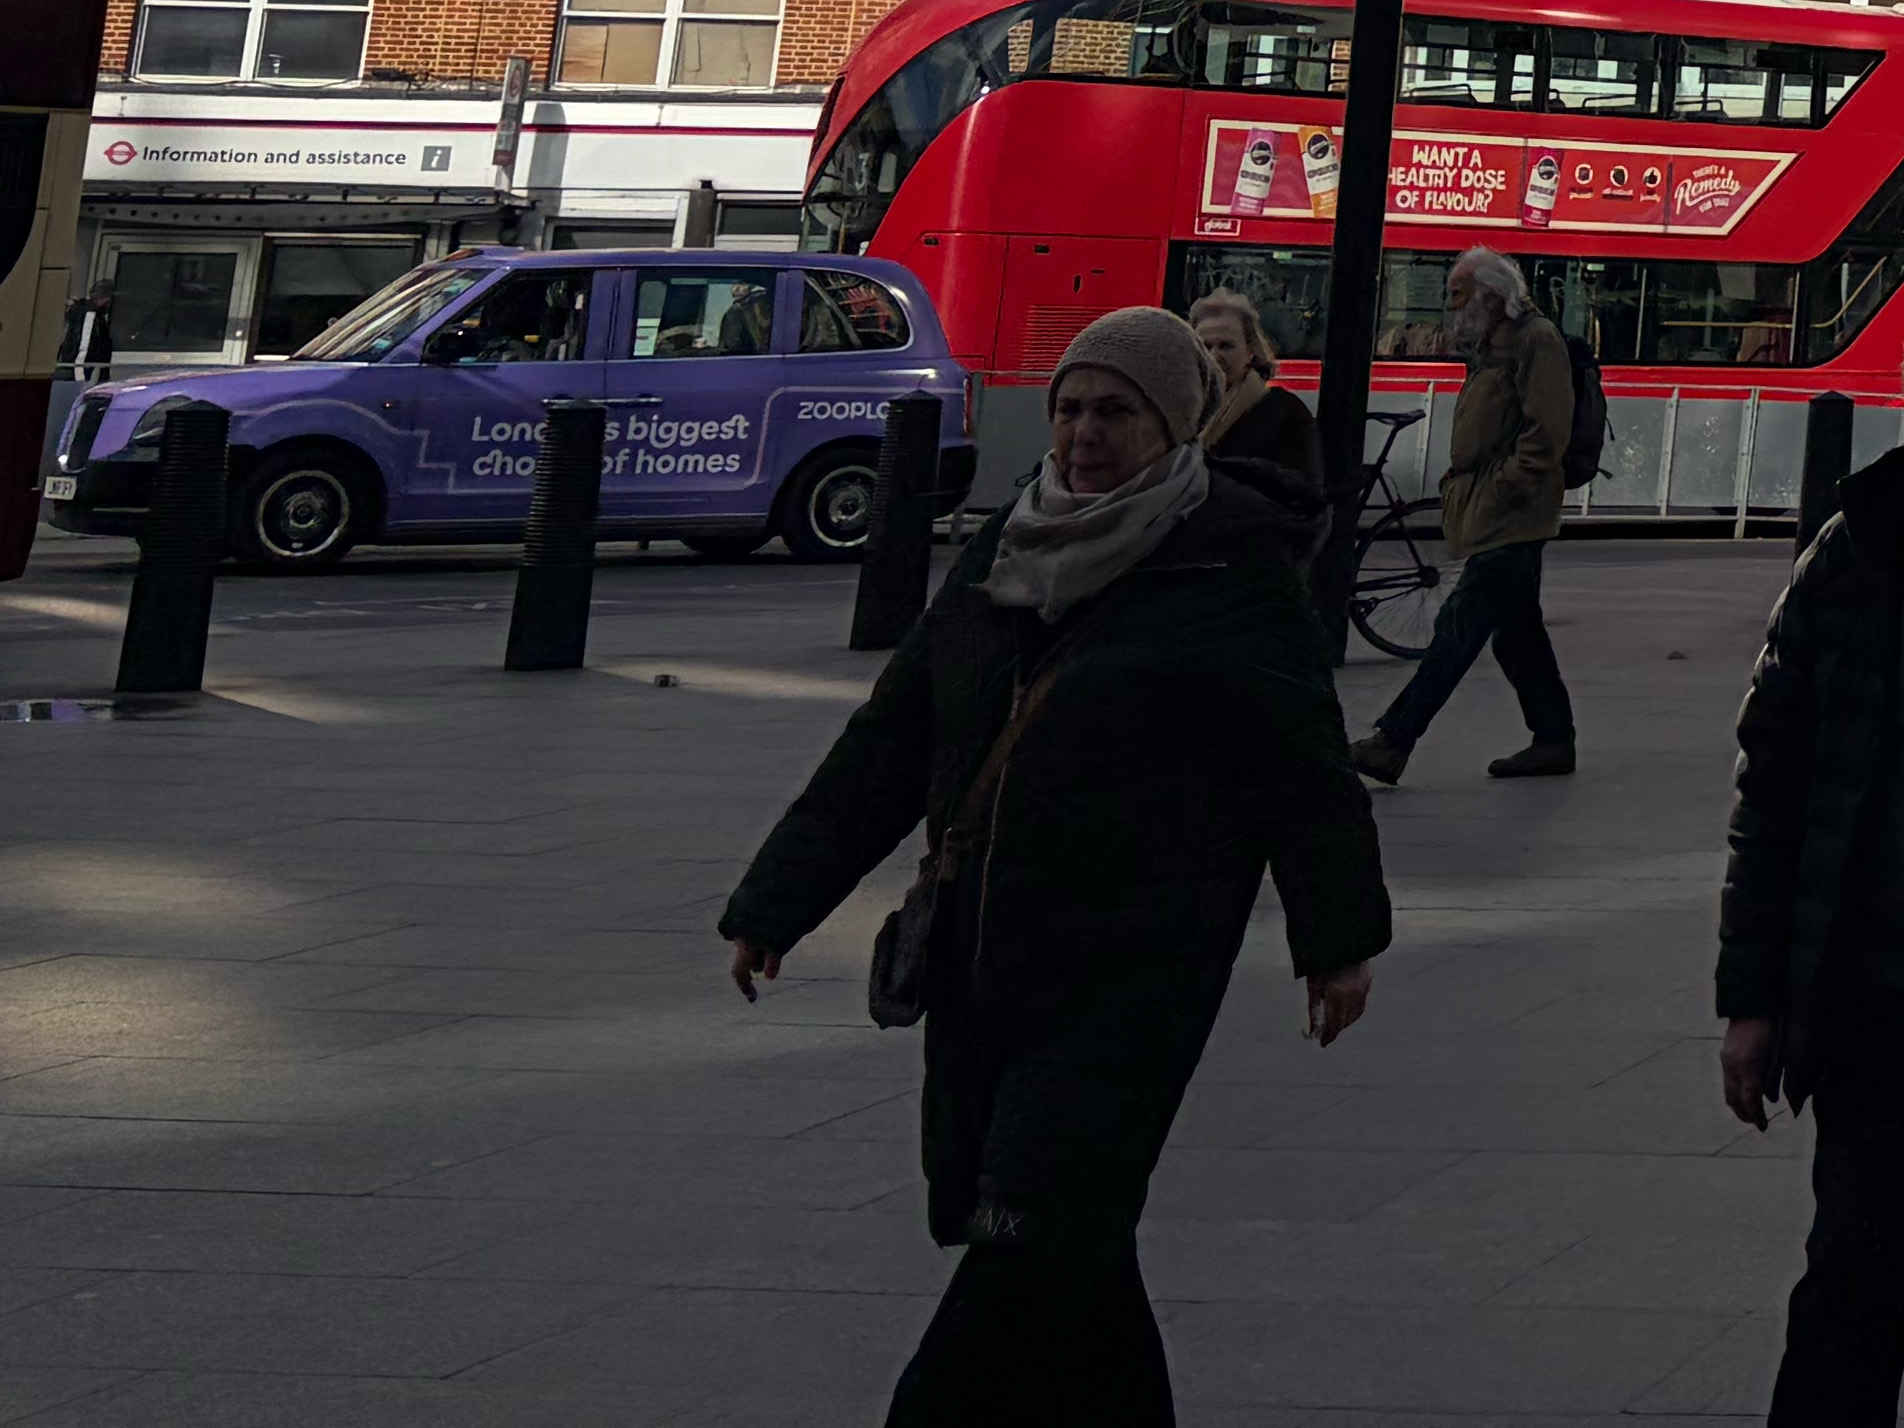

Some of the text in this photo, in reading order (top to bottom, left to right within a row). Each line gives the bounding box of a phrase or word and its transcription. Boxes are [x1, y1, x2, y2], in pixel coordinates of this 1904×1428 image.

[142, 145, 407, 166] Information and assistance
[1412, 144, 1483, 169] WANT A
[1388, 166, 1459, 189] HEALTHY
[1460, 169, 1506, 190] DOSE
[1395, 189, 1494, 213] OF FLAVOUR?
[1674, 170, 1741, 216] Remedy
[626, 414, 750, 449] biggest
[634, 449, 741, 474] homes
